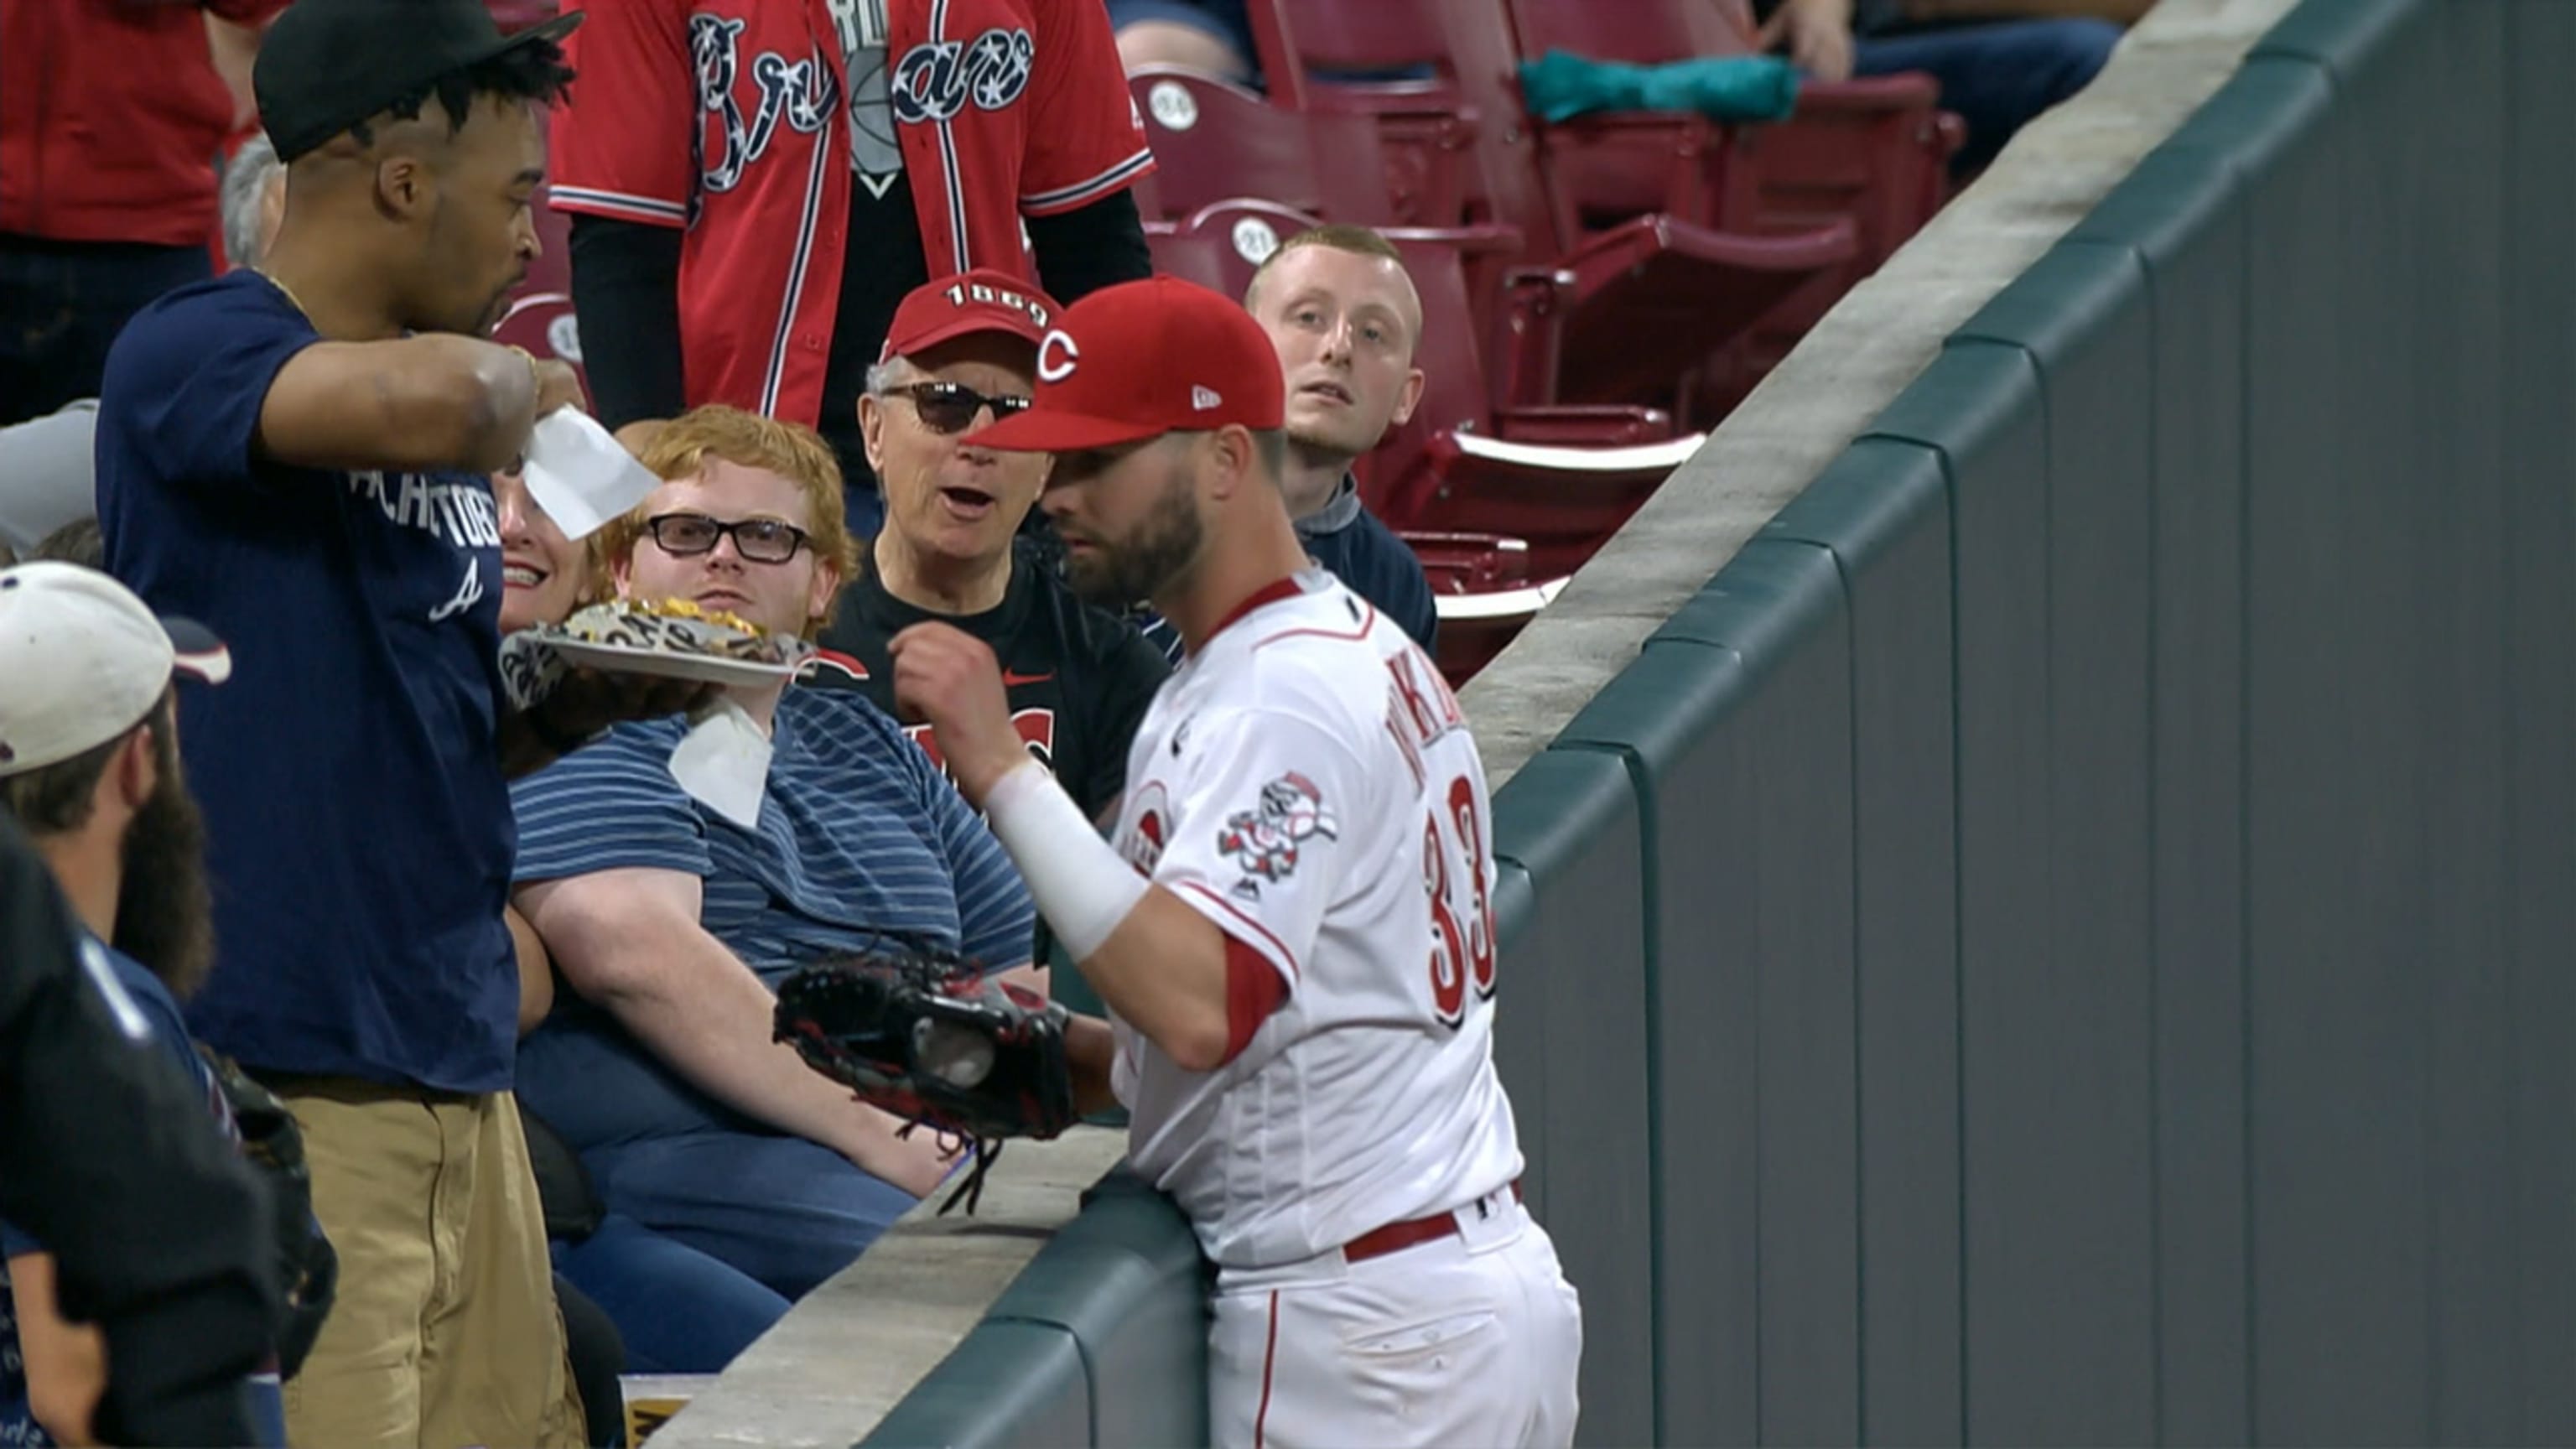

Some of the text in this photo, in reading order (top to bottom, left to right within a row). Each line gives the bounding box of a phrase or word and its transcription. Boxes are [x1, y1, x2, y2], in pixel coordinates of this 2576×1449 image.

[946, 282, 1048, 329] 1869
[1038, 329, 1079, 383] C
[428, 555, 484, 622] A
[1423, 773, 1495, 1030] 33
